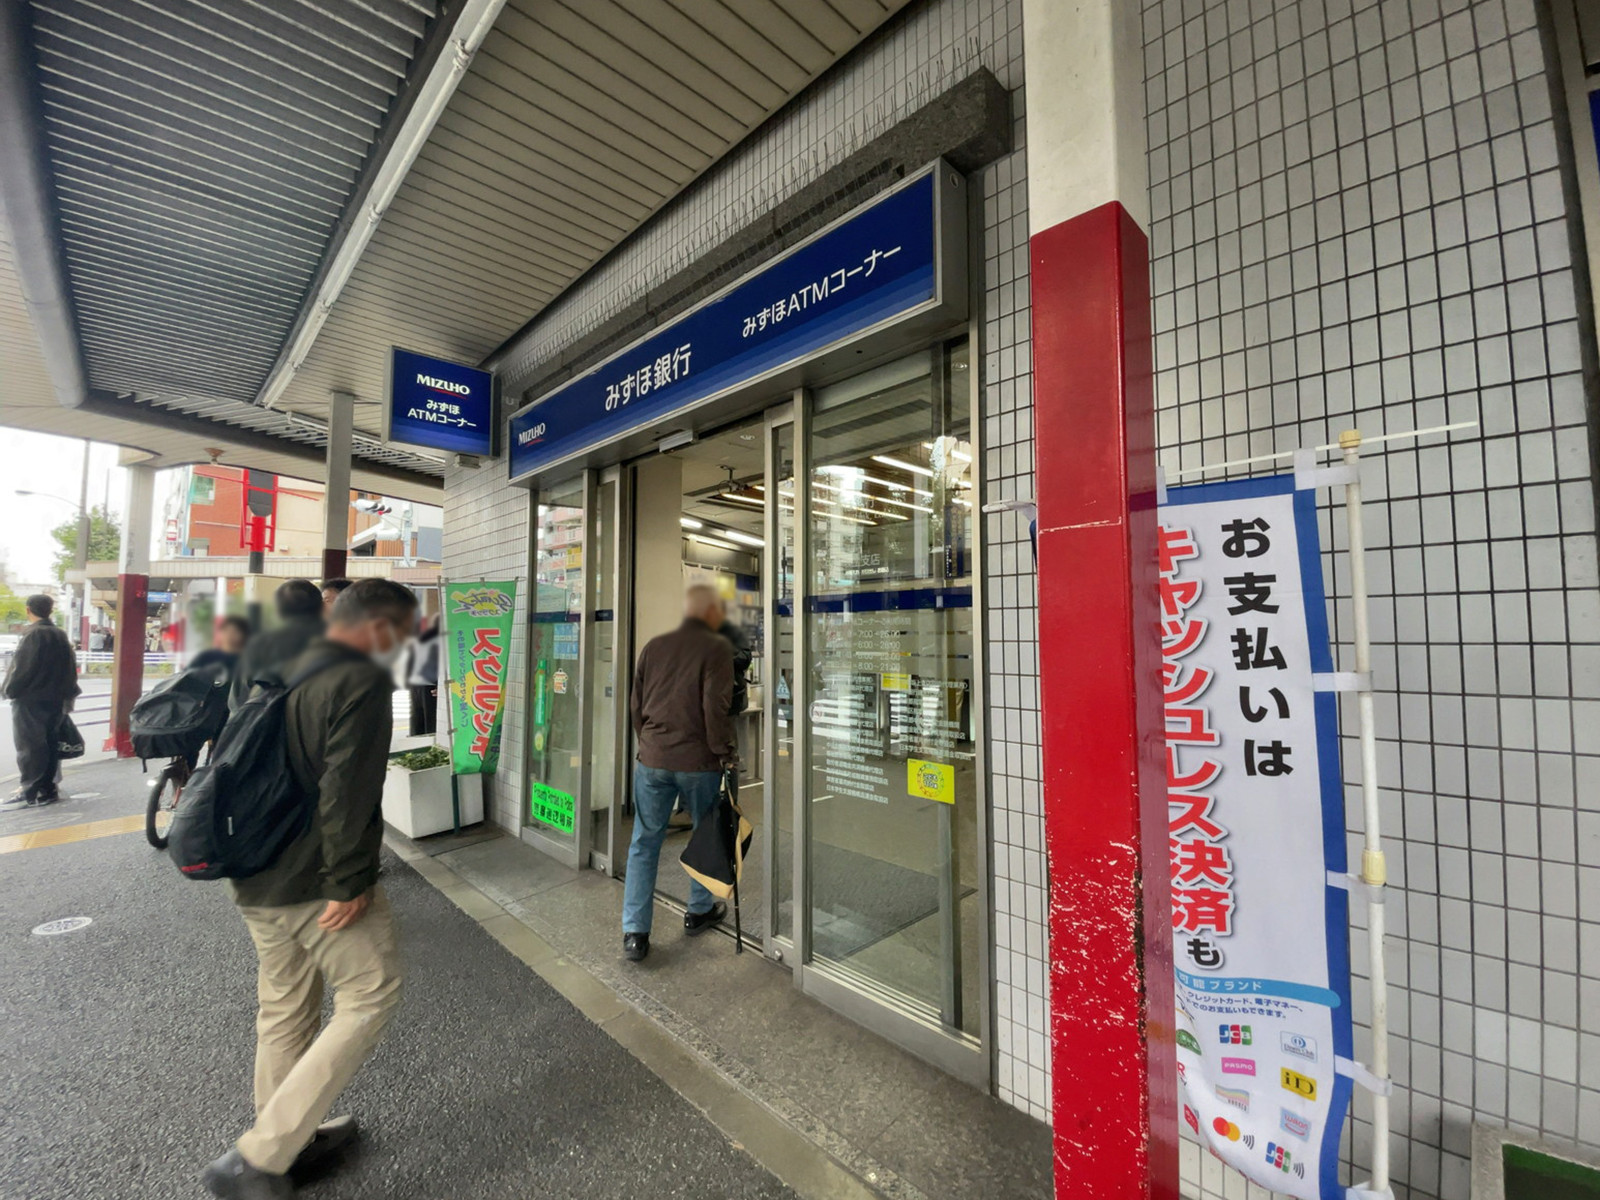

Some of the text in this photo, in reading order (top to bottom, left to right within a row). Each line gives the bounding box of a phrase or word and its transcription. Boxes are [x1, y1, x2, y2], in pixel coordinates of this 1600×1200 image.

[742, 246, 901, 338] みずほATMコーナー
[416, 373, 471, 395] MIZUHO
[604, 343, 691, 411] みずほ銀行
[407, 407, 477, 428] ATMコーナー
[426, 400, 460, 415] みずほ
[518, 423, 546, 446] MIZUHO
[1221, 517, 1294, 777] お支払いは
[1285, 1071, 1315, 1095] iD
